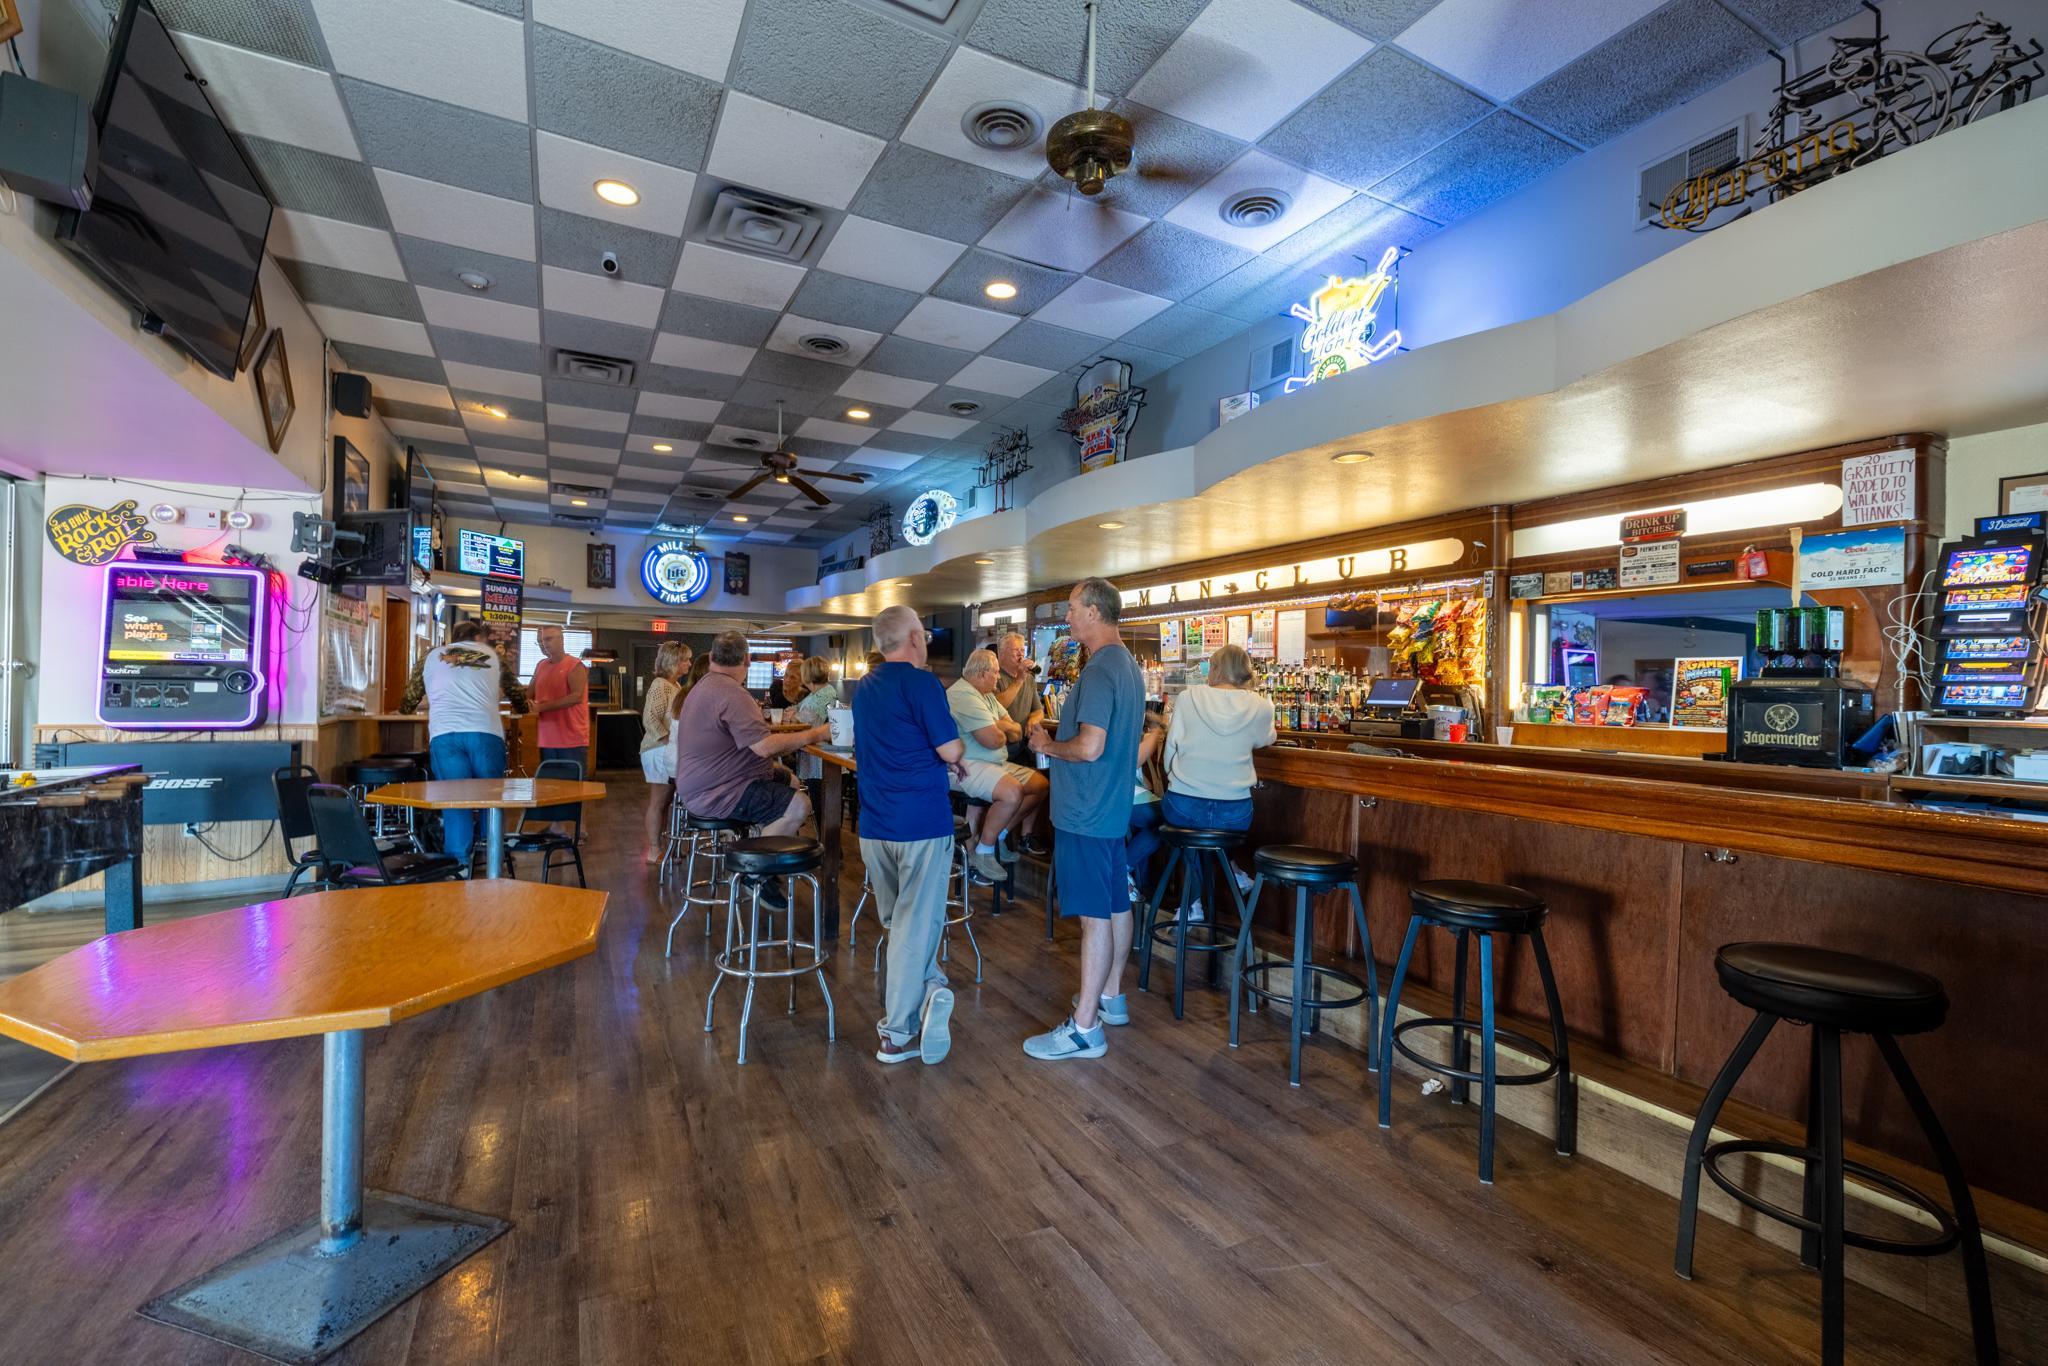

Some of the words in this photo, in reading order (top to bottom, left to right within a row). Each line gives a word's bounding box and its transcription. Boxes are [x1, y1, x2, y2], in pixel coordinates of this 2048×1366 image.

[1661, 121, 1860, 230] Corona
[1300, 308, 1366, 353] Golden
[1845, 459, 1915, 481] GRATUITY
[1850, 477, 1890, 494] ADDED
[1893, 476, 1906, 489] TO
[1848, 492, 1878, 509] WALK
[1881, 489, 1907, 503] OUTS
[1852, 503, 1904, 523] THANKS!
[52, 521, 70, 537] IT'S
[68, 509, 92, 528] ONLY
[1625, 517, 1661, 530] DRINK
[1664, 514, 1680, 524] UP
[55, 511, 115, 555] ROCK
[1632, 524, 1674, 537] BITCHES!
[76, 544, 92, 562] &
[89, 521, 140, 557] ROLL
[1640, 545, 1661, 553] PAYMENT
[1662, 543, 1678, 551] NOTICE
[667, 568, 687, 580] Lite
[1138, 580, 1211, 607] MAN
[1256, 549, 1408, 591] CLUB
[1811, 570, 1833, 578] COLD
[1835, 568, 1860, 576] HARD
[161, 577, 209, 591] Here
[485, 584, 518, 595] SUNDAY
[485, 592, 517, 605] MEAT
[660, 590, 688, 603] TIME
[485, 603, 517, 613] RAFFLE
[124, 614, 148, 623] See
[490, 613, 515, 621] 1:30PM
[124, 622, 163, 631] what's
[654, 622, 667, 632] EXIT
[124, 630, 168, 641] playing
[1686, 660, 1725, 670] GAME
[142, 778, 223, 790] BOSE
